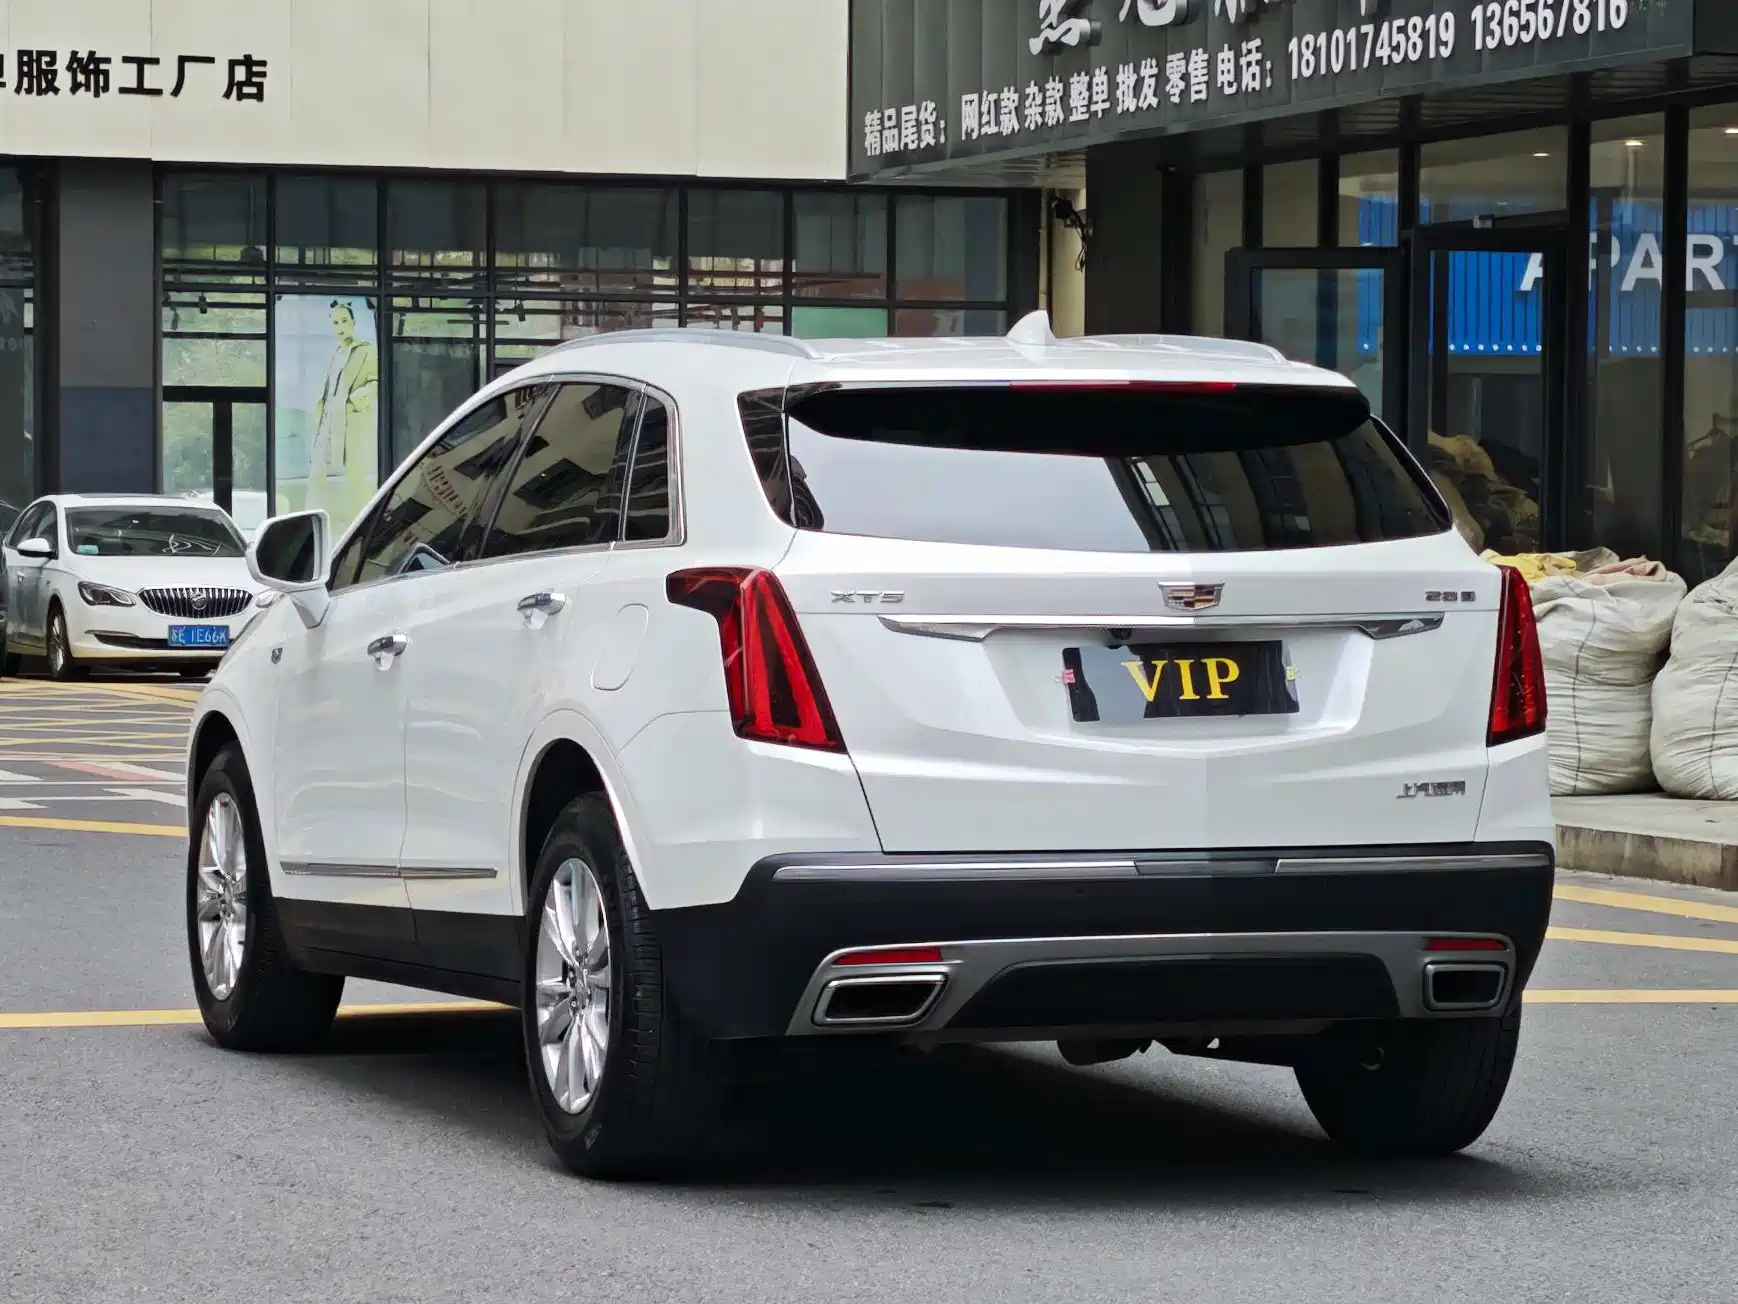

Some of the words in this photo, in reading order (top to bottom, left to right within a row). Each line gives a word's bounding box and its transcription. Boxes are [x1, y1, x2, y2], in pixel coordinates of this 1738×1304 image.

[0, 49, 268, 102] 服饰工厂店
[961, 86, 1020, 140] 网红款
[1024, 75, 1064, 130] 杂款
[1068, 66, 1111, 122] 整单
[1116, 57, 1159, 114] 批发
[1165, 48, 1209, 104] 零售
[1288, 12, 1456, 80] 18101745819
[830, 589, 905, 604] XT5
[1120, 657, 1241, 702] VIP
